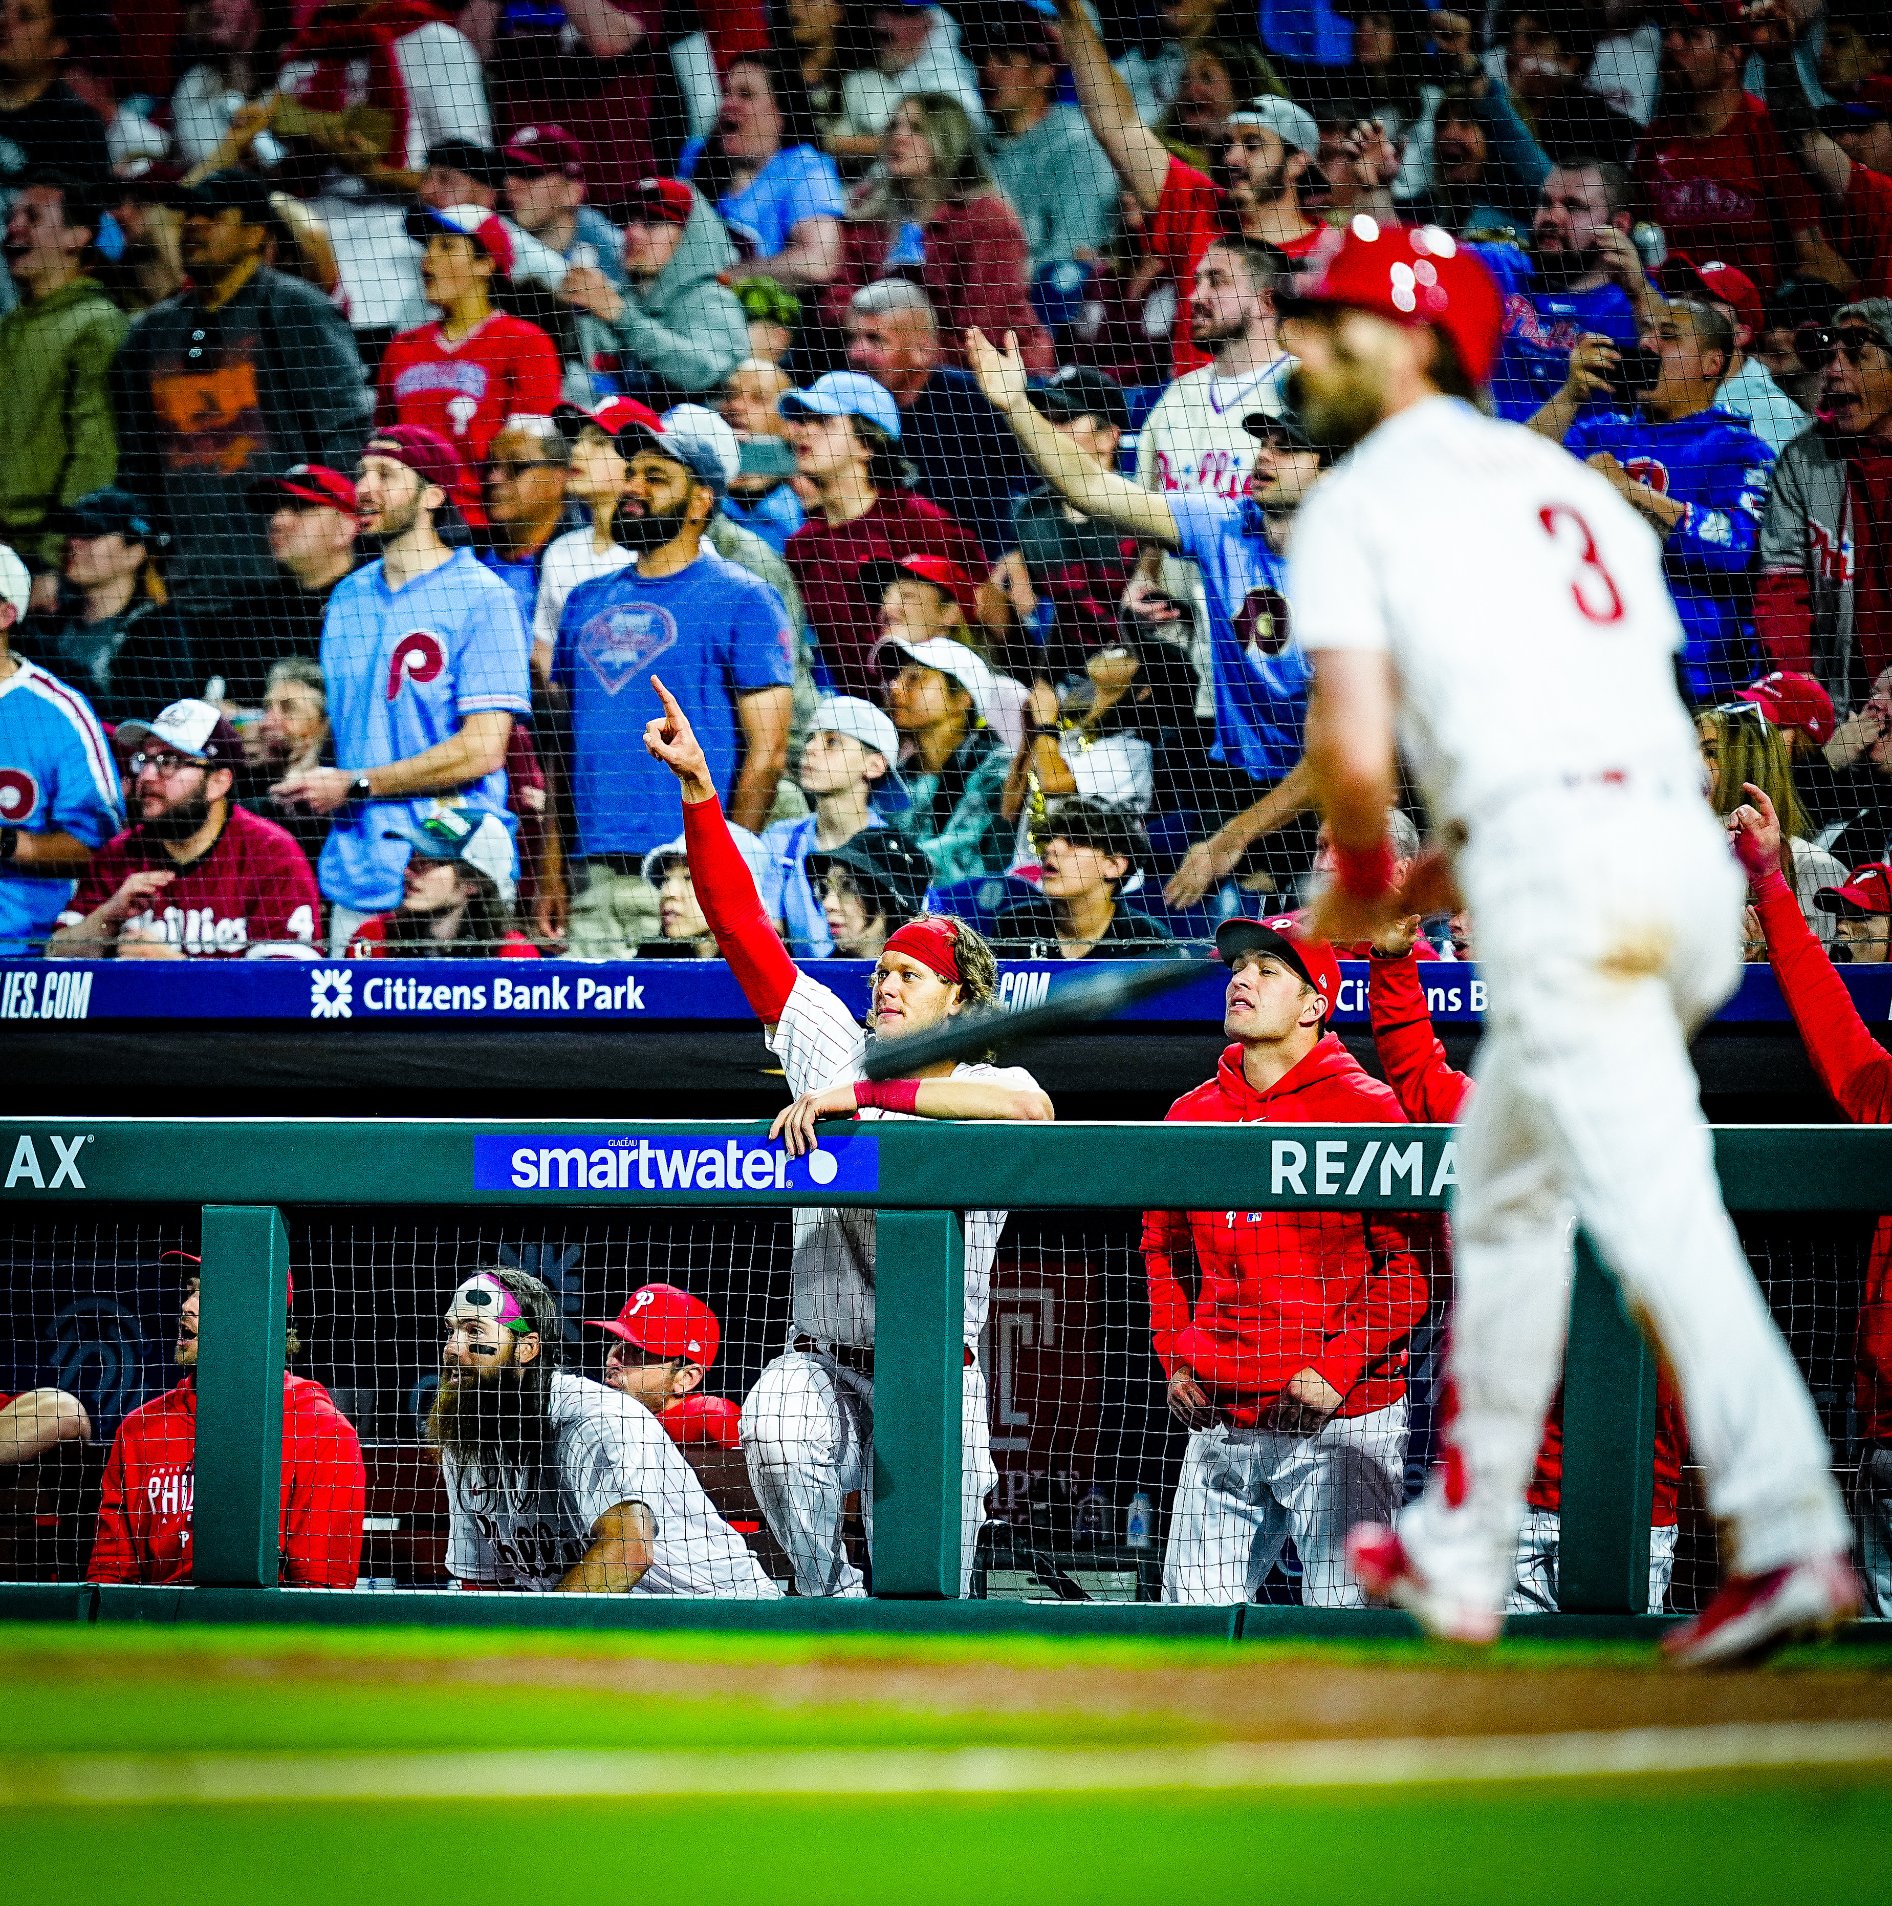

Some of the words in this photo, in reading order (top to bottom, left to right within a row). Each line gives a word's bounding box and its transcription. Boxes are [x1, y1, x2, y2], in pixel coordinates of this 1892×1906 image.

[1538, 501, 1625, 626] 3
[122, 906, 248, 954] hillies
[287, 904, 315, 943] 4
[0, 971, 94, 1019] IES.COM
[363, 977, 487, 1010] Citizens
[493, 976, 570, 1010] Bank
[577, 976, 645, 1010] Park
[511, 1139, 795, 1189] smartwater
[629, 1289, 655, 1316] P
